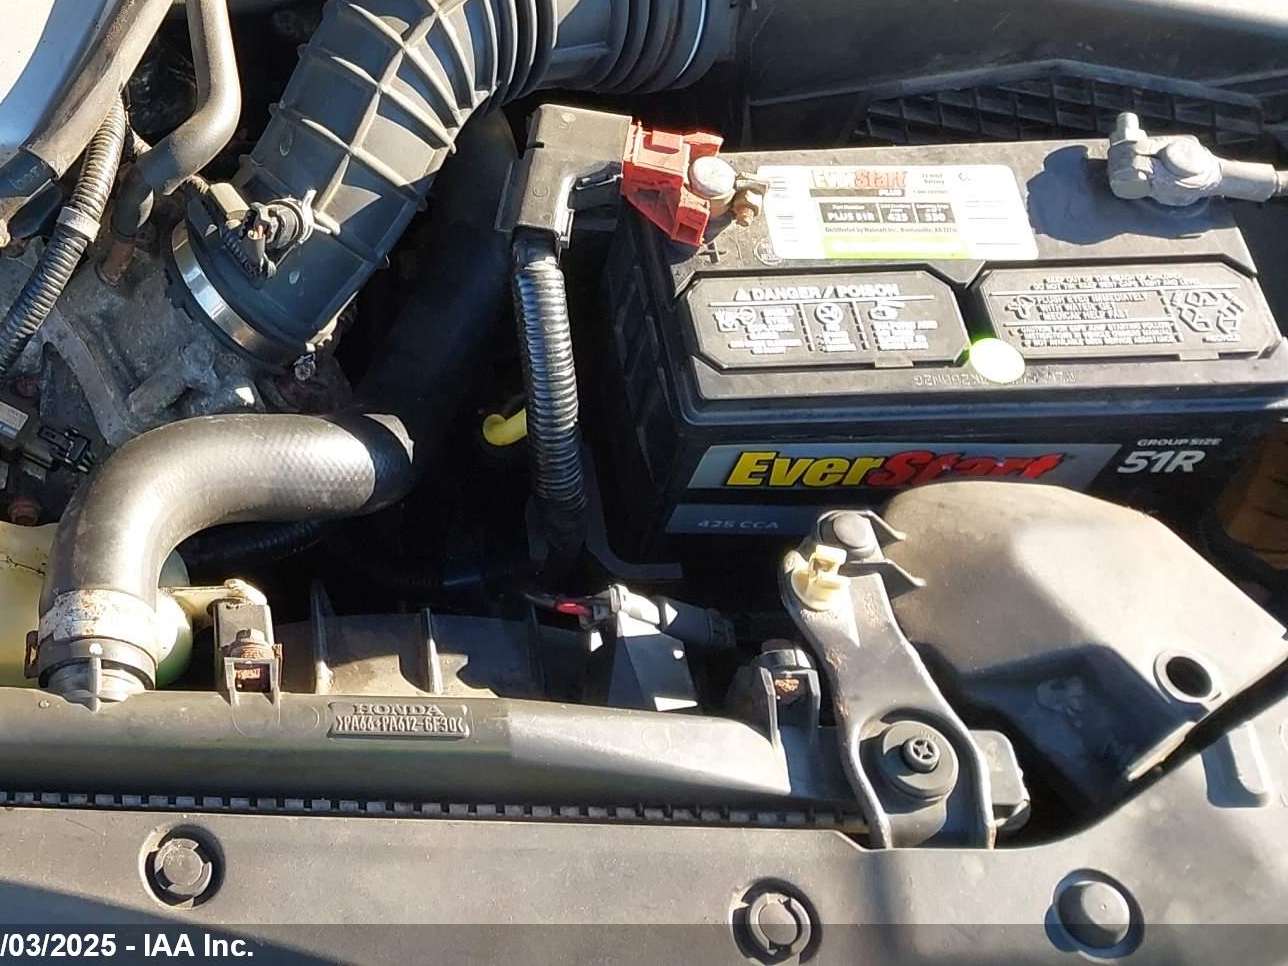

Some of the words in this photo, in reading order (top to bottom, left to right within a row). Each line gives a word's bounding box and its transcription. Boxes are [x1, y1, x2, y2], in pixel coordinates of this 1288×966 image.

[751, 286, 821, 301] DANGER
[1137, 438, 1189, 447] GROUP
[1190, 437, 1223, 446] SIZE
[725, 449, 1065, 488] EverStart
[1117, 450, 1207, 474] 51R
[697, 520, 735, 529] 425
[738, 520, 779, 530] CCA
[352, 703, 445, 716] HONDA
